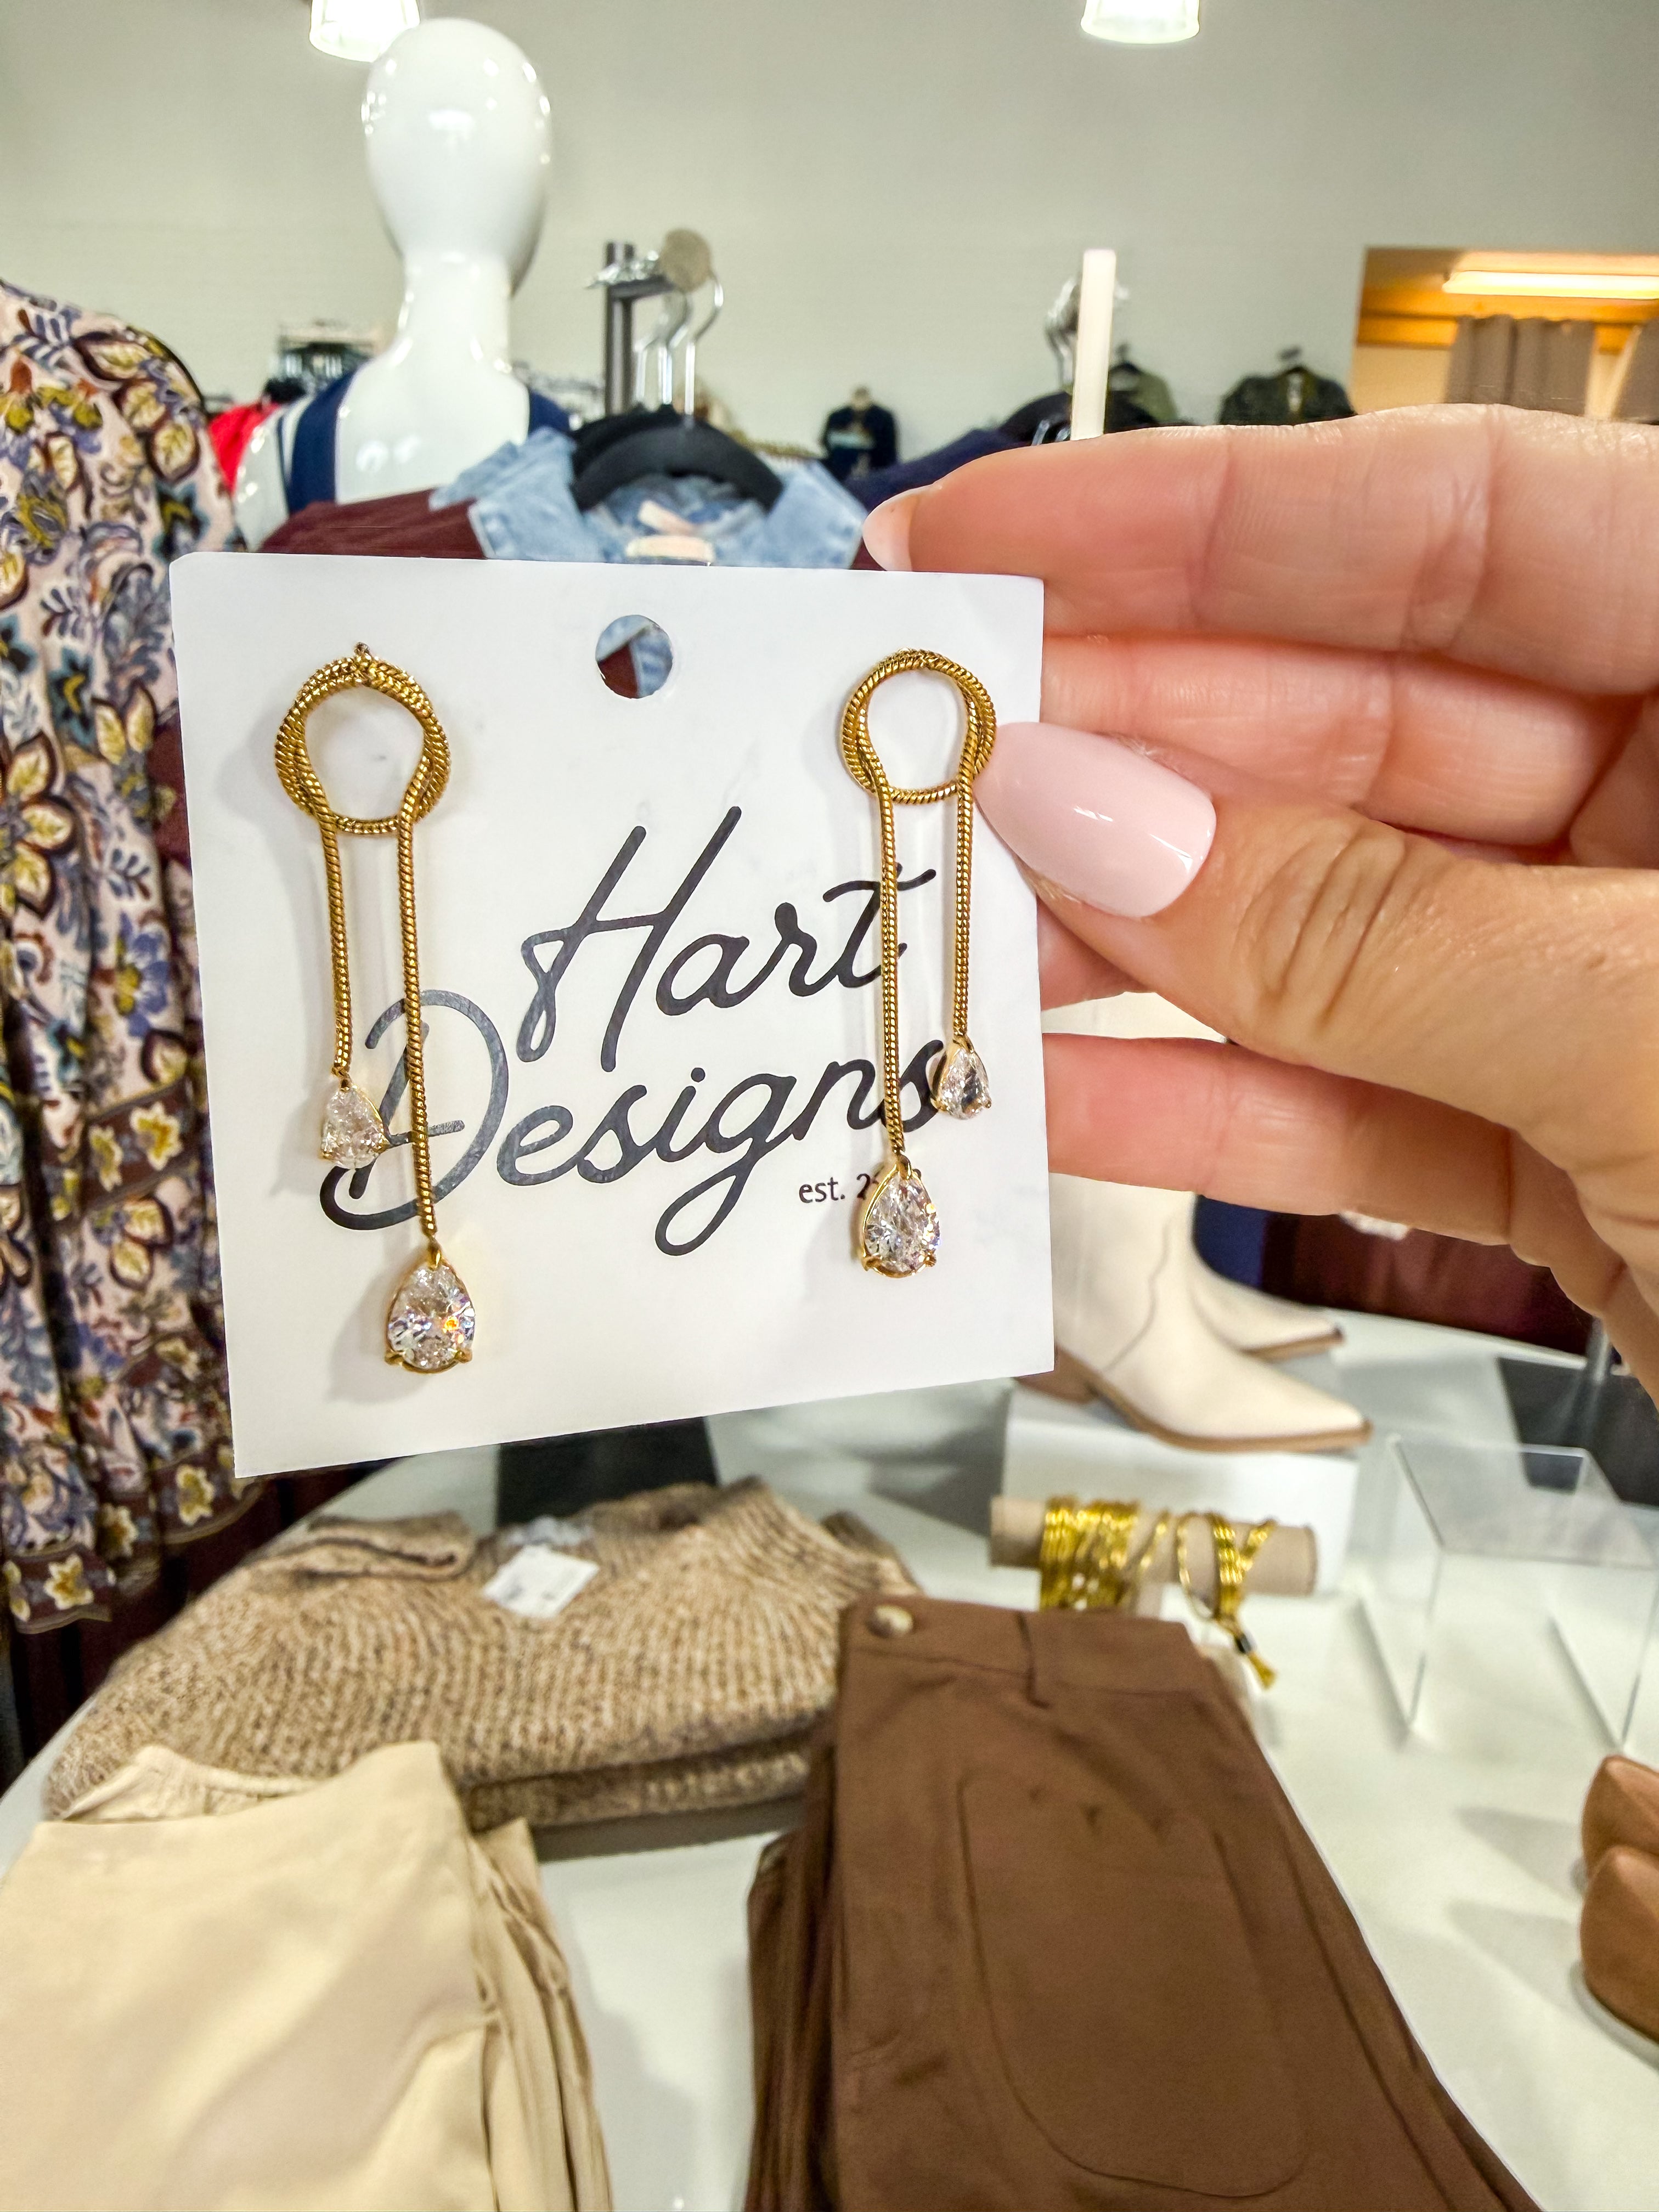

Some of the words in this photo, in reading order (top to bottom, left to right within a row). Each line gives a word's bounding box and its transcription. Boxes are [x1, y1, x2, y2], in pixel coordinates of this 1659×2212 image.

[517, 806, 936, 1071] Hart
[320, 989, 944, 1255] Designs
[799, 1177, 845, 1203] est.
